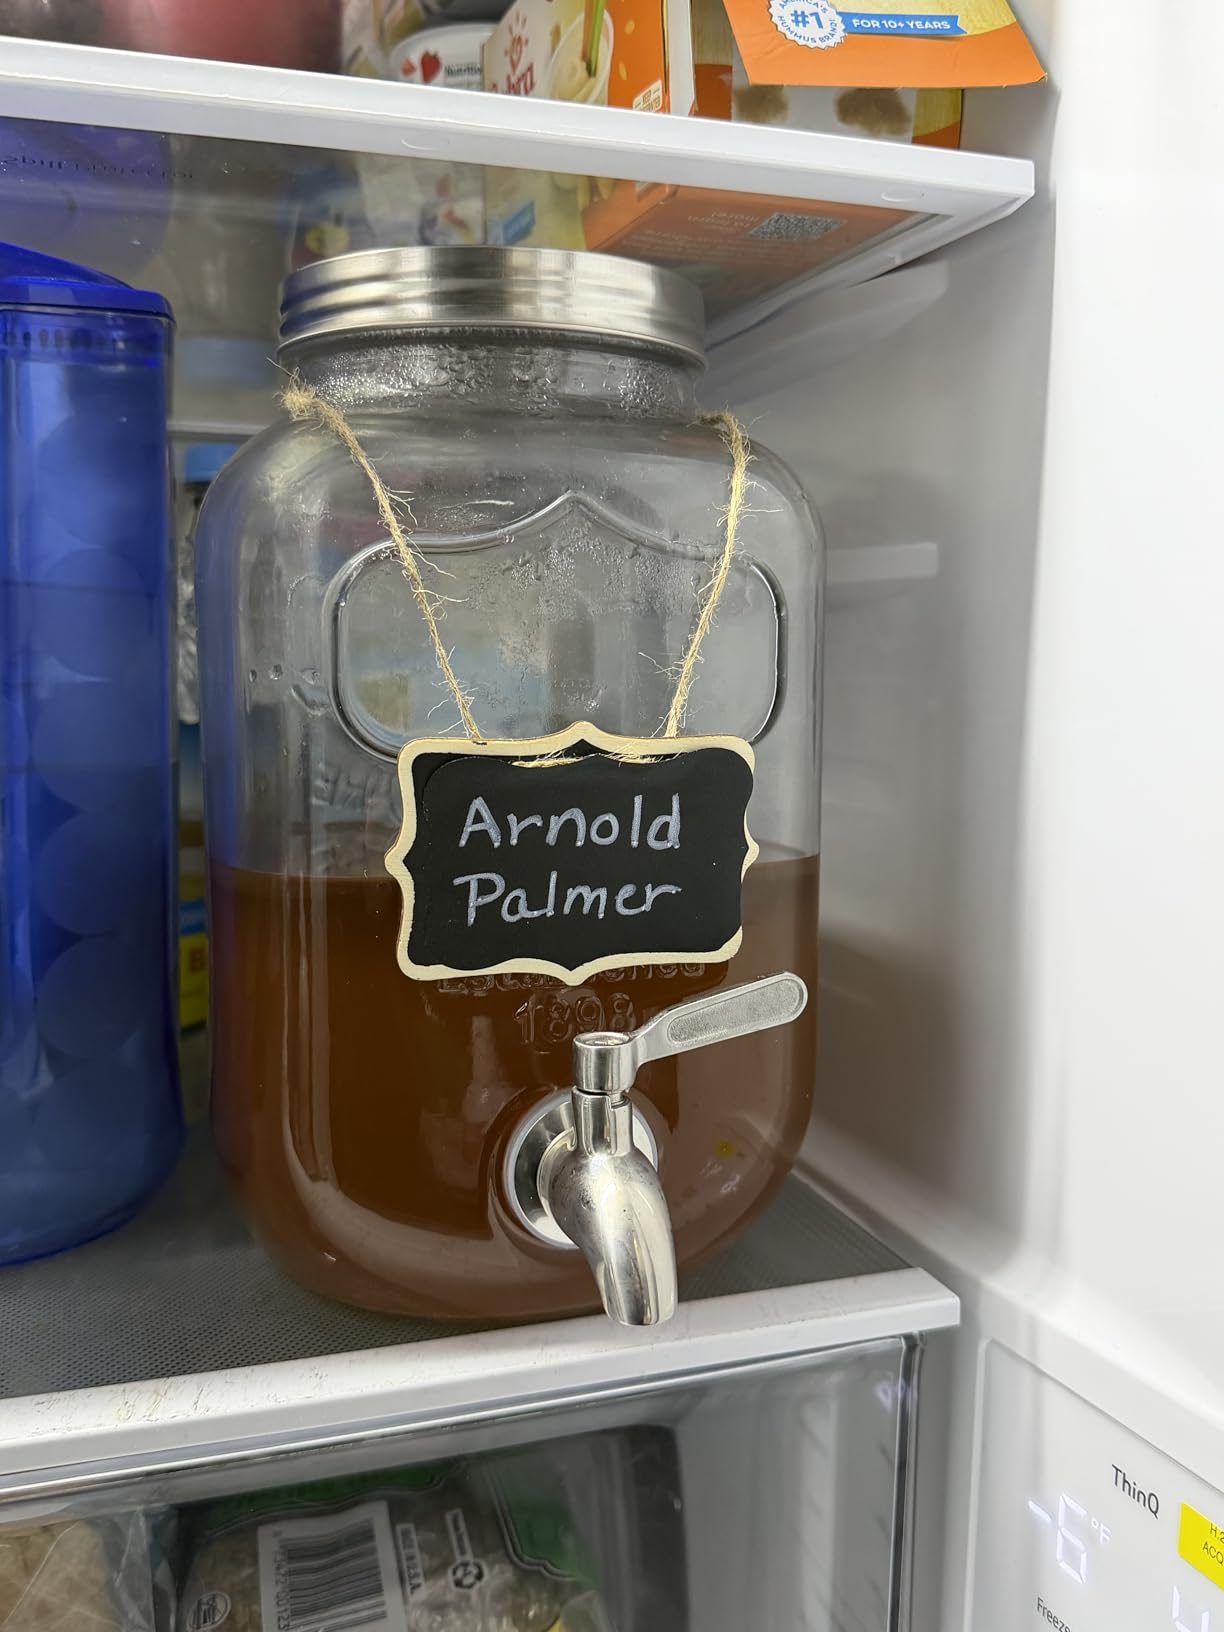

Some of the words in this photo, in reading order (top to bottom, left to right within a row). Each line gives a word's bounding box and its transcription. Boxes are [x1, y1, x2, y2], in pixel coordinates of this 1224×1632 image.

[777, 15, 817, 44] HUMMUS
[790, 9, 824, 30] #1
[851, 18, 881, 29] FOR
[881, 19, 905, 29] 10+
[905, 20, 951, 30] YEARS
[488, 62, 535, 96] bra
[457, 792, 682, 852] Arnold
[452, 870, 683, 927] Palmer
[513, 992, 637, 1045] 1898
[1111, 1463, 1160, 1520] ThinQ
[1037, 1597, 1073, 1632] Freeze
